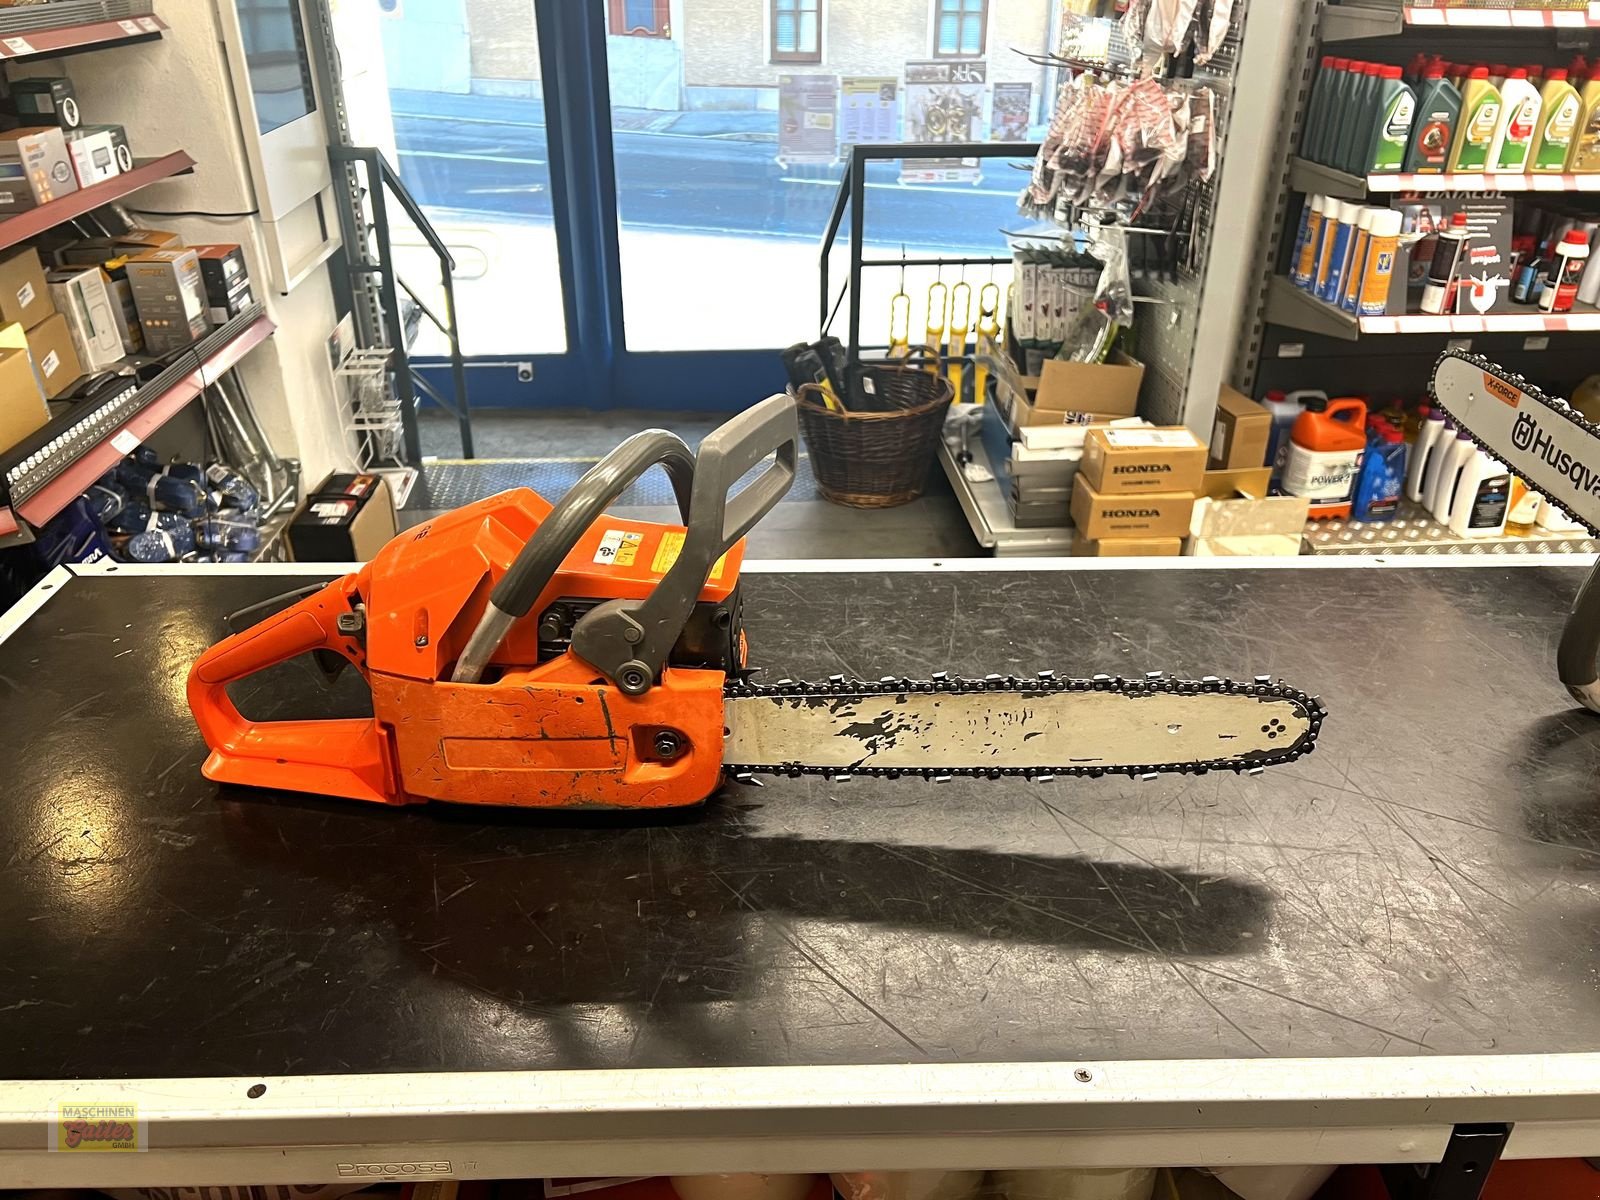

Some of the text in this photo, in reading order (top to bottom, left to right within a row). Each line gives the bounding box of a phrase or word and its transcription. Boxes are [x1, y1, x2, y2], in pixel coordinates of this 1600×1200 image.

[1487, 378, 1518, 402] X-FORCE
[1113, 464, 1172, 474] HONDA
[1102, 509, 1160, 518] HONDA
